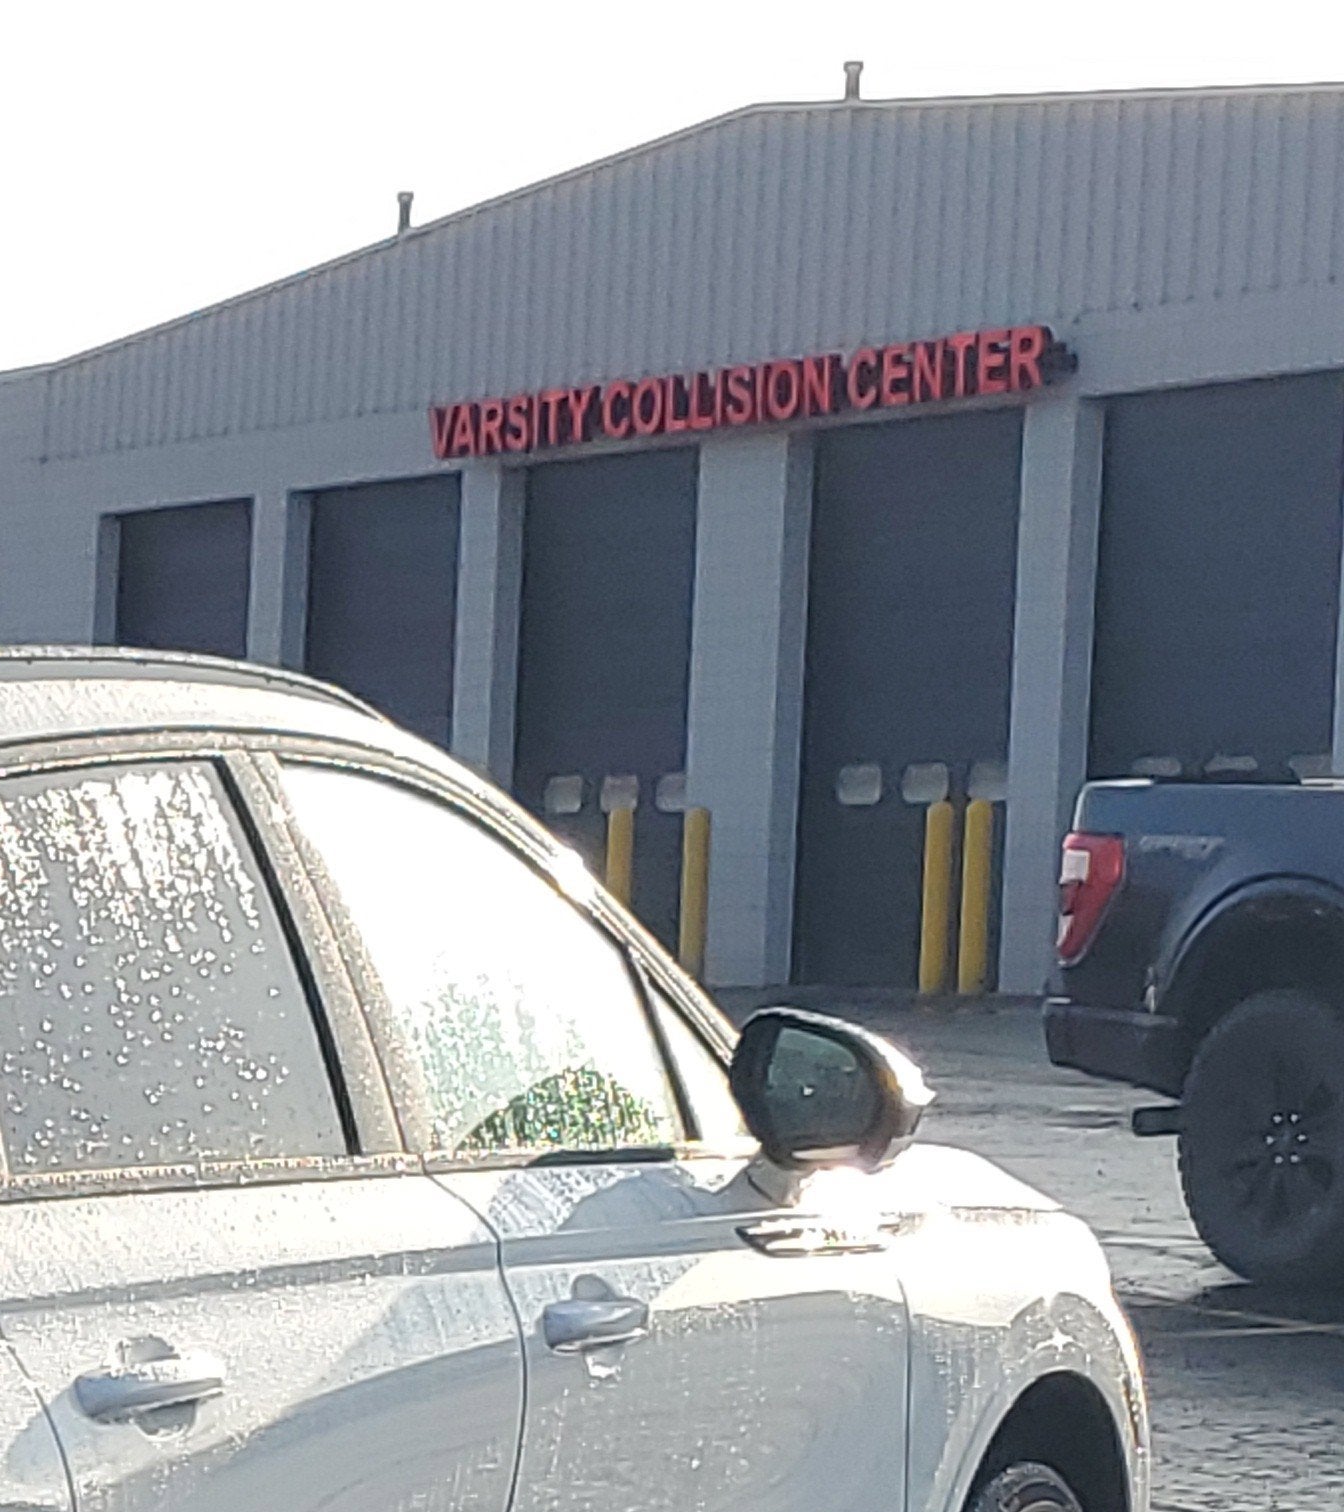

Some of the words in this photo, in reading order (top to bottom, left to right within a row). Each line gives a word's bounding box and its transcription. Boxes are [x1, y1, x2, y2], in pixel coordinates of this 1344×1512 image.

[428, 386, 599, 460] VARSITY
[603, 355, 835, 440] COLLISION
[847, 325, 1054, 409] CENTER
